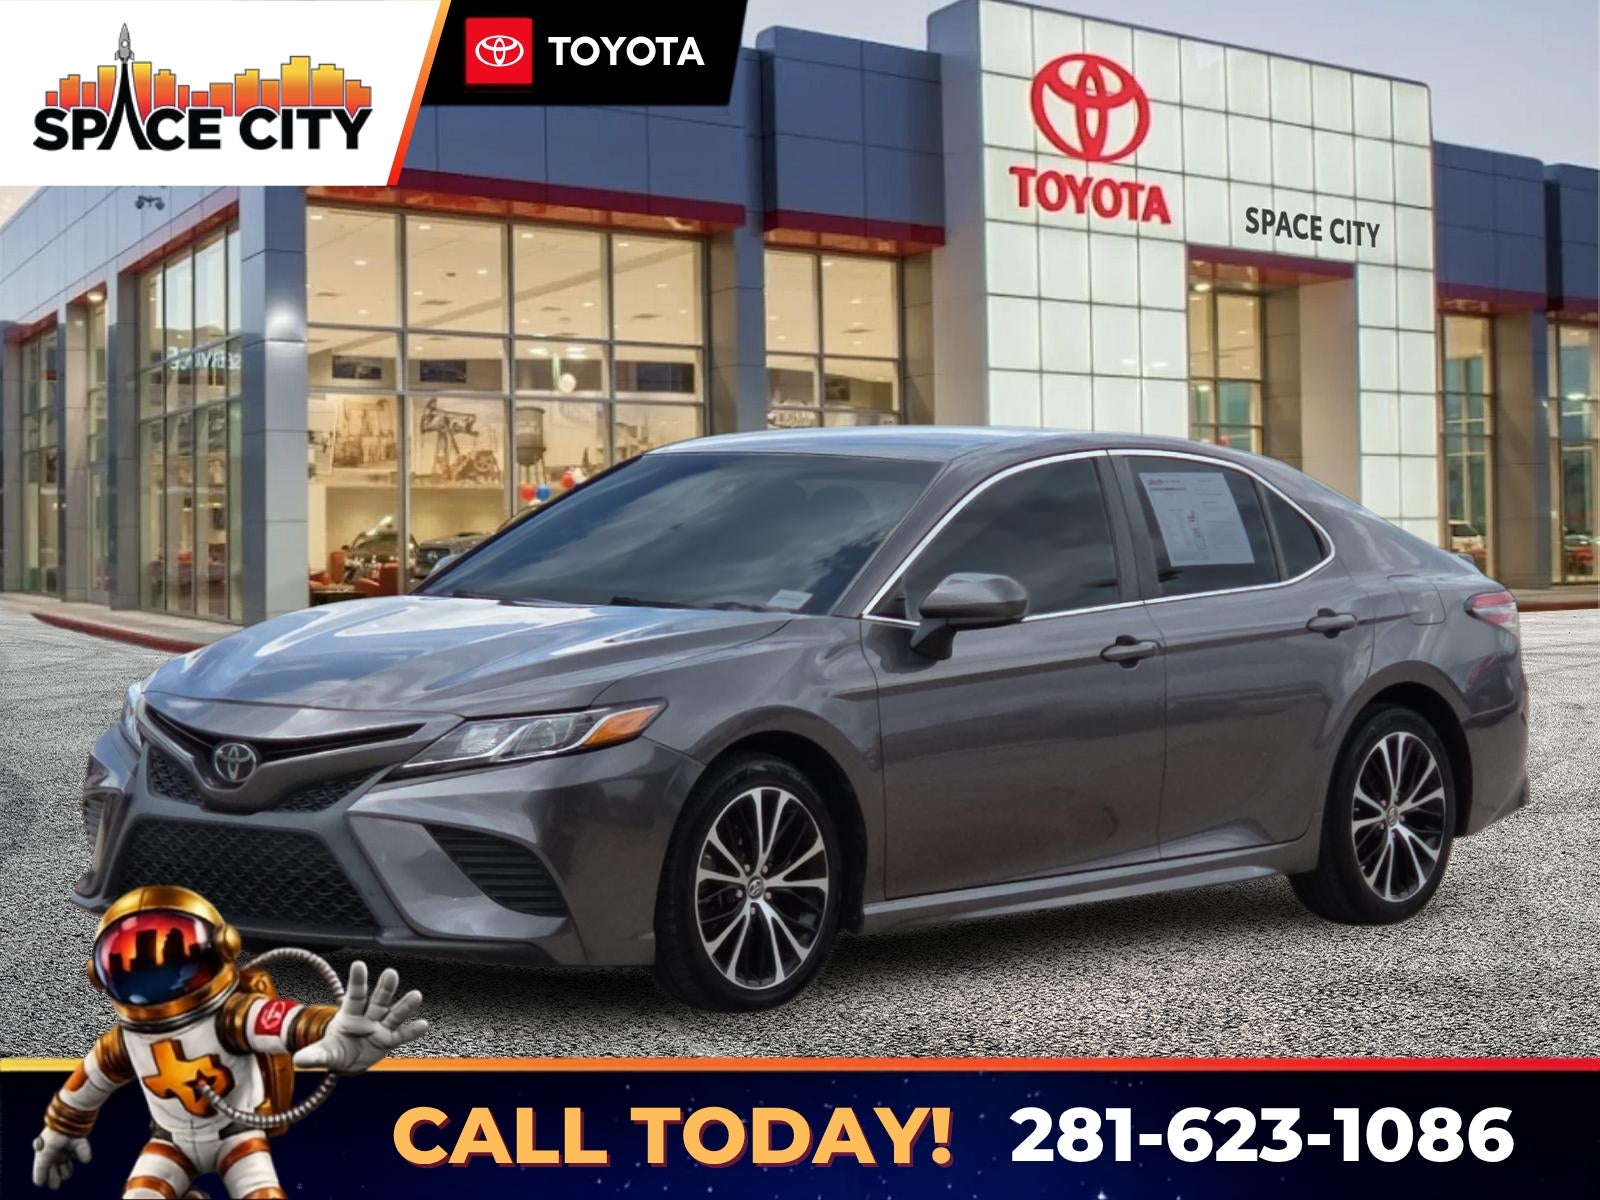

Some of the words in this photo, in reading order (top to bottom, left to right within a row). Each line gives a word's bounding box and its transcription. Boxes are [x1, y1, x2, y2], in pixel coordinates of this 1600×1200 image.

[1009, 166, 1171, 224] TOYOTA
[1245, 207, 1322, 241] SPACE
[1329, 217, 1381, 248] CITY
